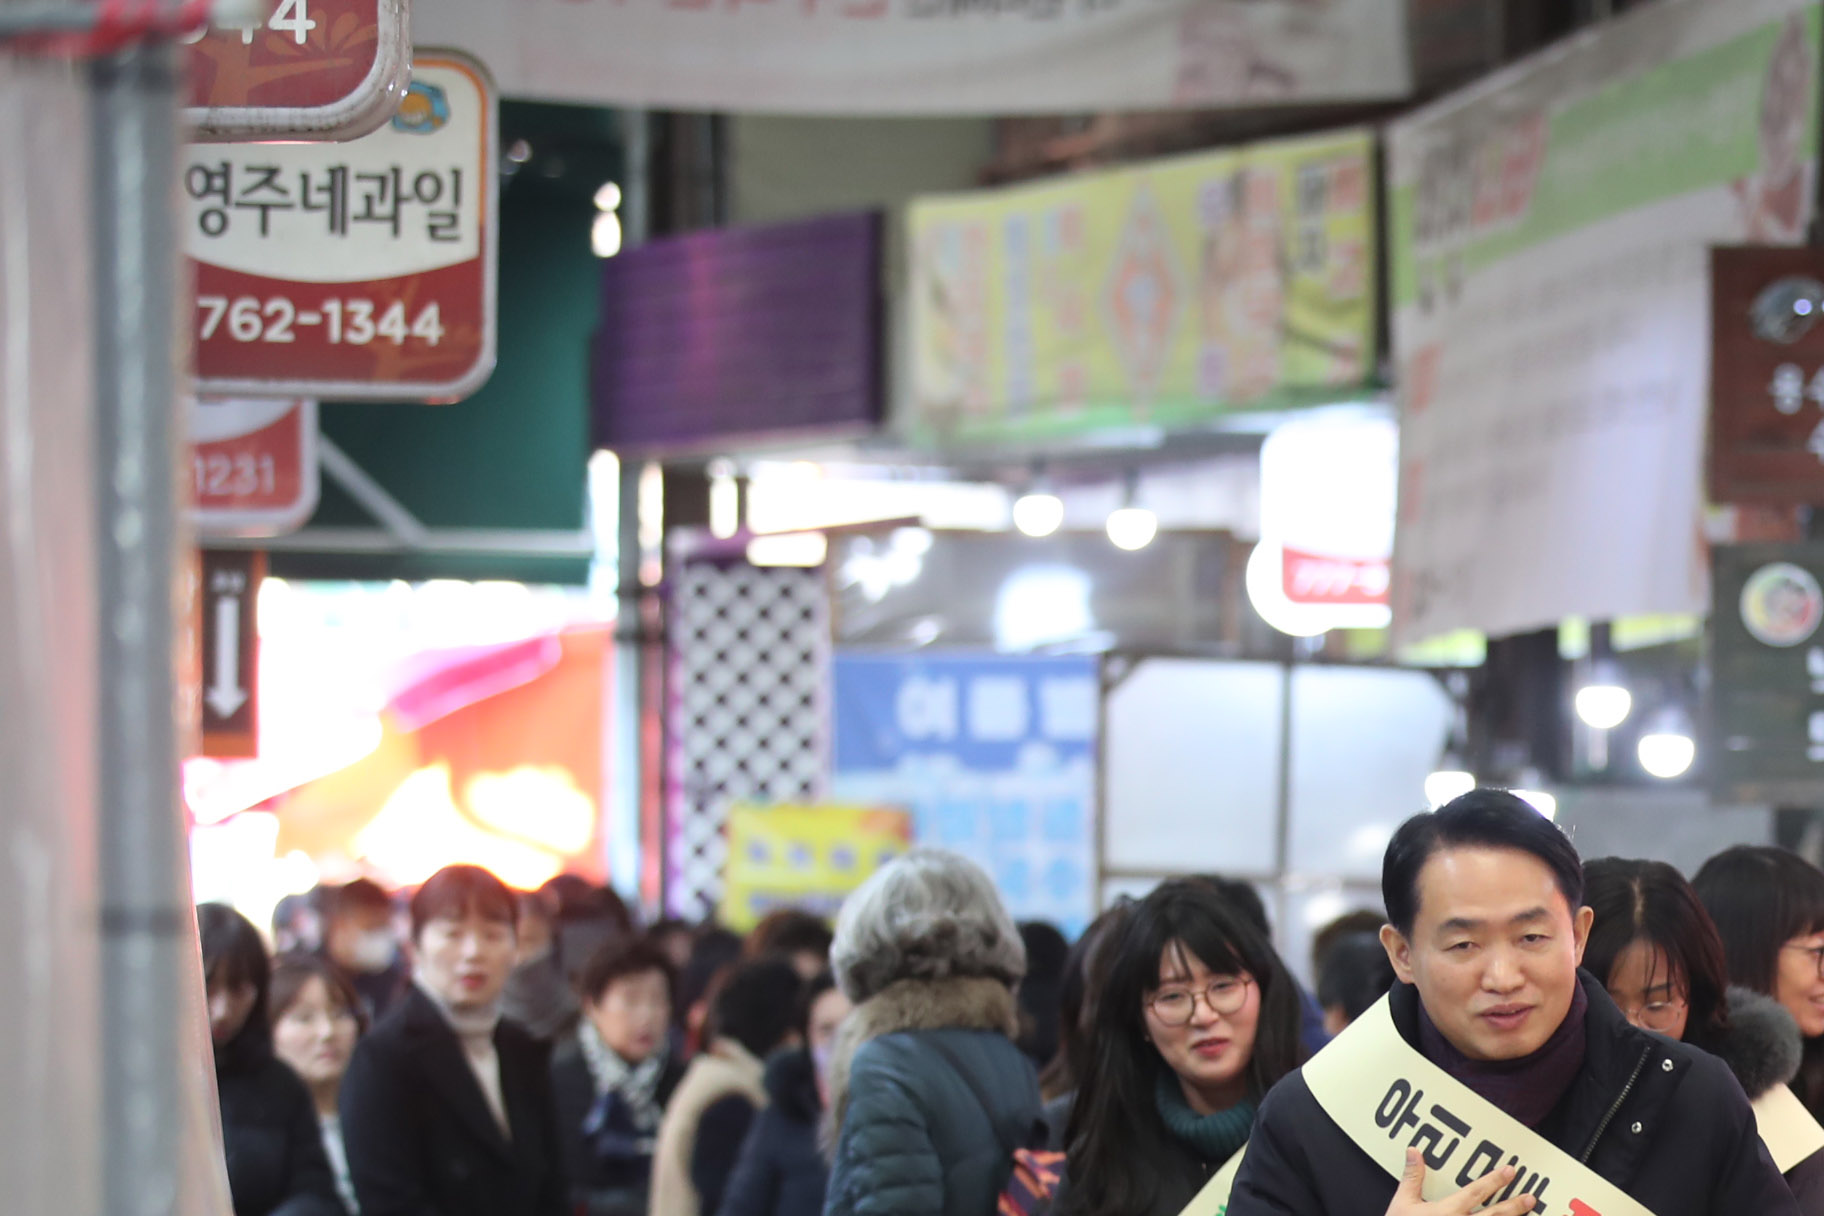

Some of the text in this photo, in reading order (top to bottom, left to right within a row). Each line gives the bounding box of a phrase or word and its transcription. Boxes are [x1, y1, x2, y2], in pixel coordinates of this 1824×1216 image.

[185, 162, 463, 242] 영주네과일
[197, 297, 445, 345] 762-1344
[1375, 1078, 1472, 1171] 우리
